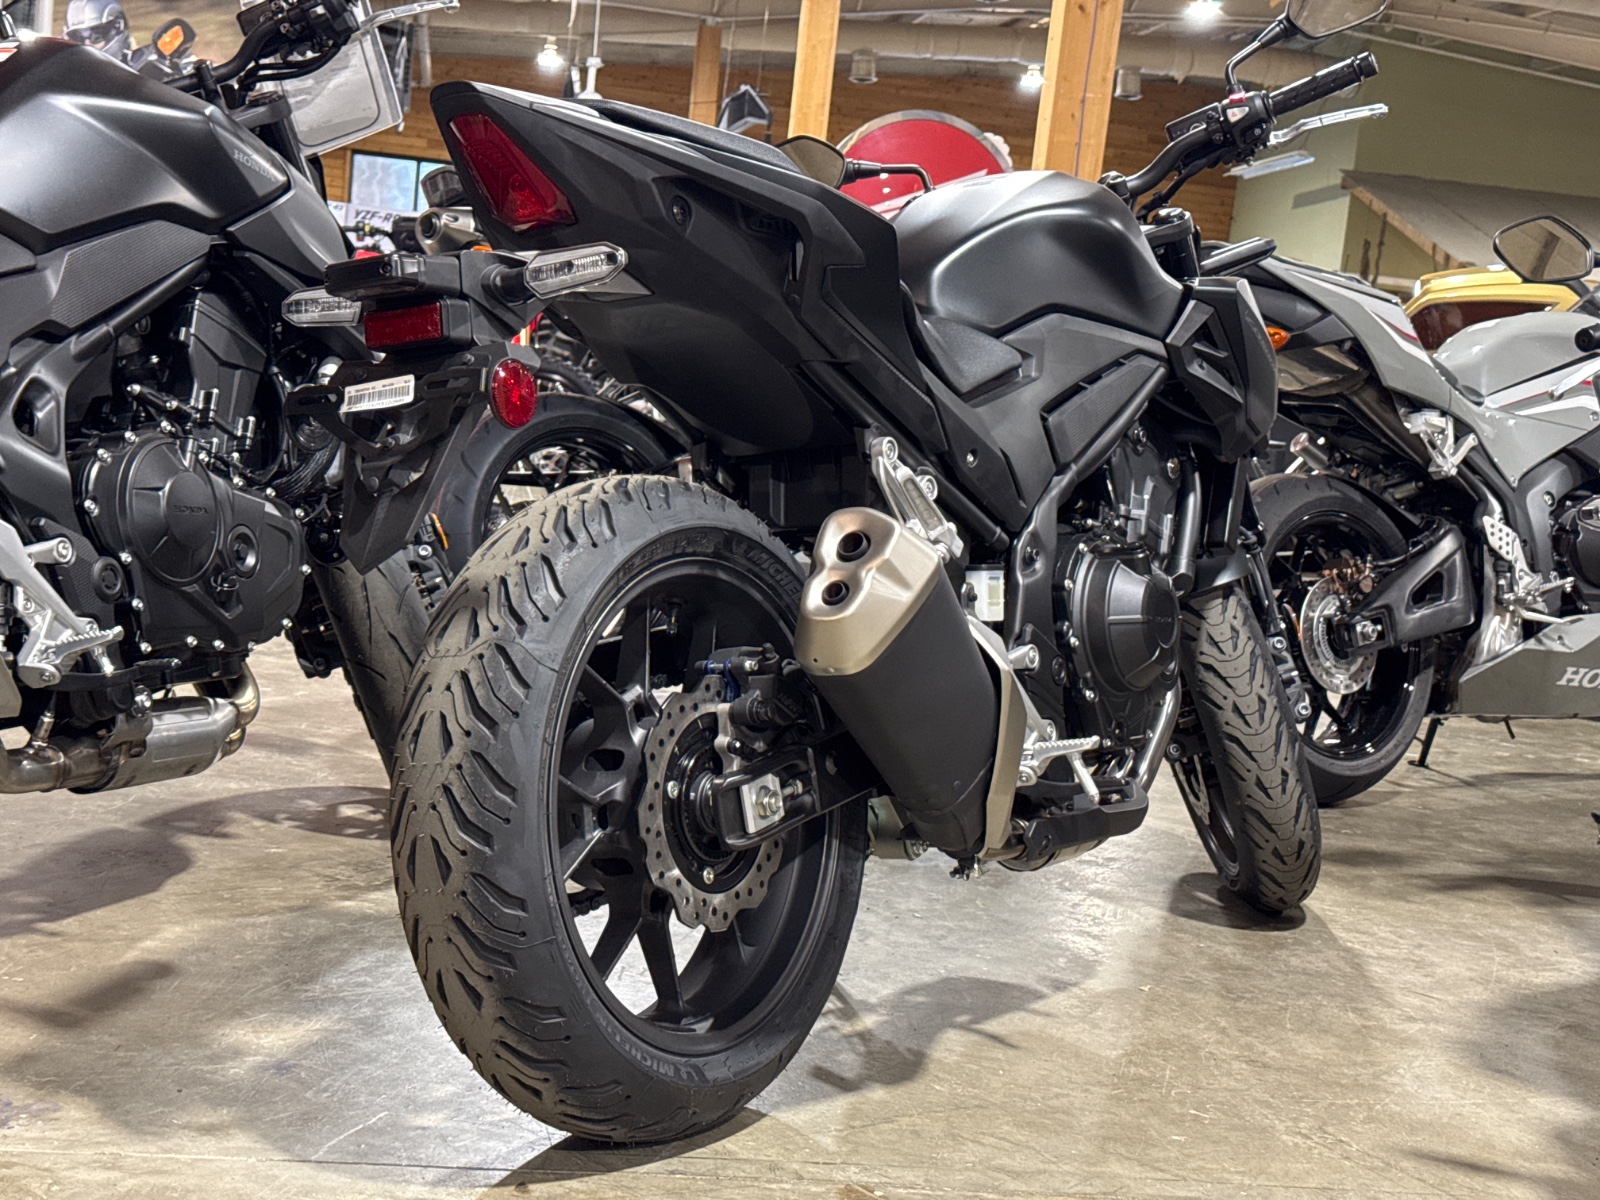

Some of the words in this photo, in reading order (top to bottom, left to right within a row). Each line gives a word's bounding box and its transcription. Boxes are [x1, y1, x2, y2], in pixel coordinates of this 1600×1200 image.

[233, 149, 276, 182] HONDA
[747, 549, 802, 608] MICHEL
[1555, 666, 1600, 688] HO
[599, 1013, 676, 1077] MICHELIN
